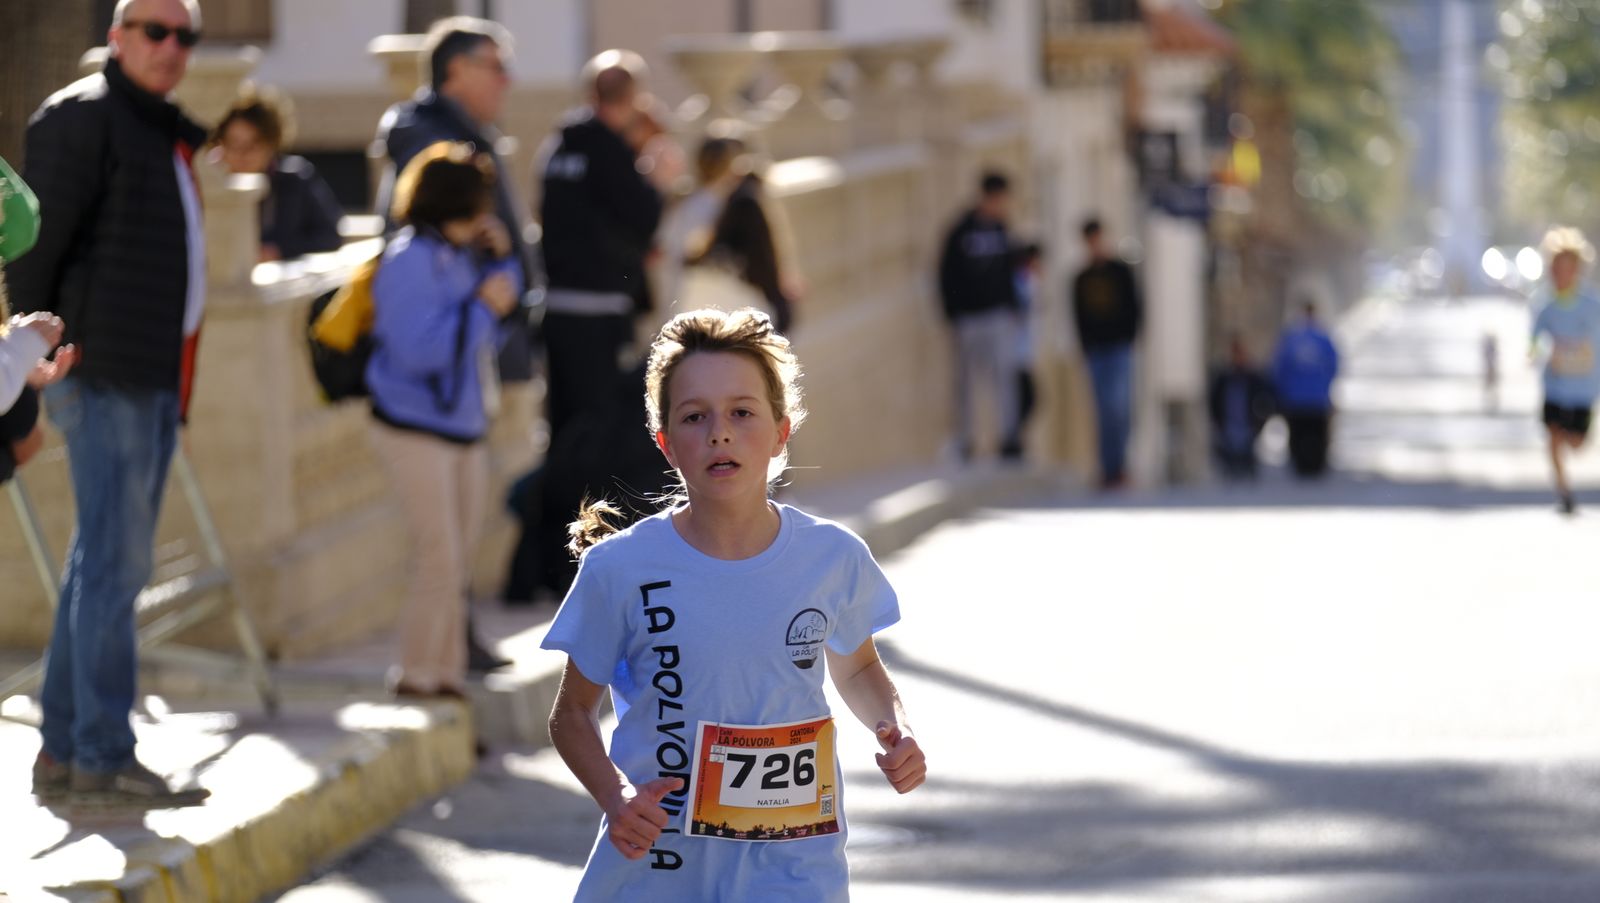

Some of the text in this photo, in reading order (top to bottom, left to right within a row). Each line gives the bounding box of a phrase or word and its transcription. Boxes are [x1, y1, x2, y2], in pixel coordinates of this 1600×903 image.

[640, 580, 676, 634] LA
[718, 736, 775, 747] LA PÓLVORA
[790, 727, 815, 737] CANTORIA
[727, 749, 815, 789] 726
